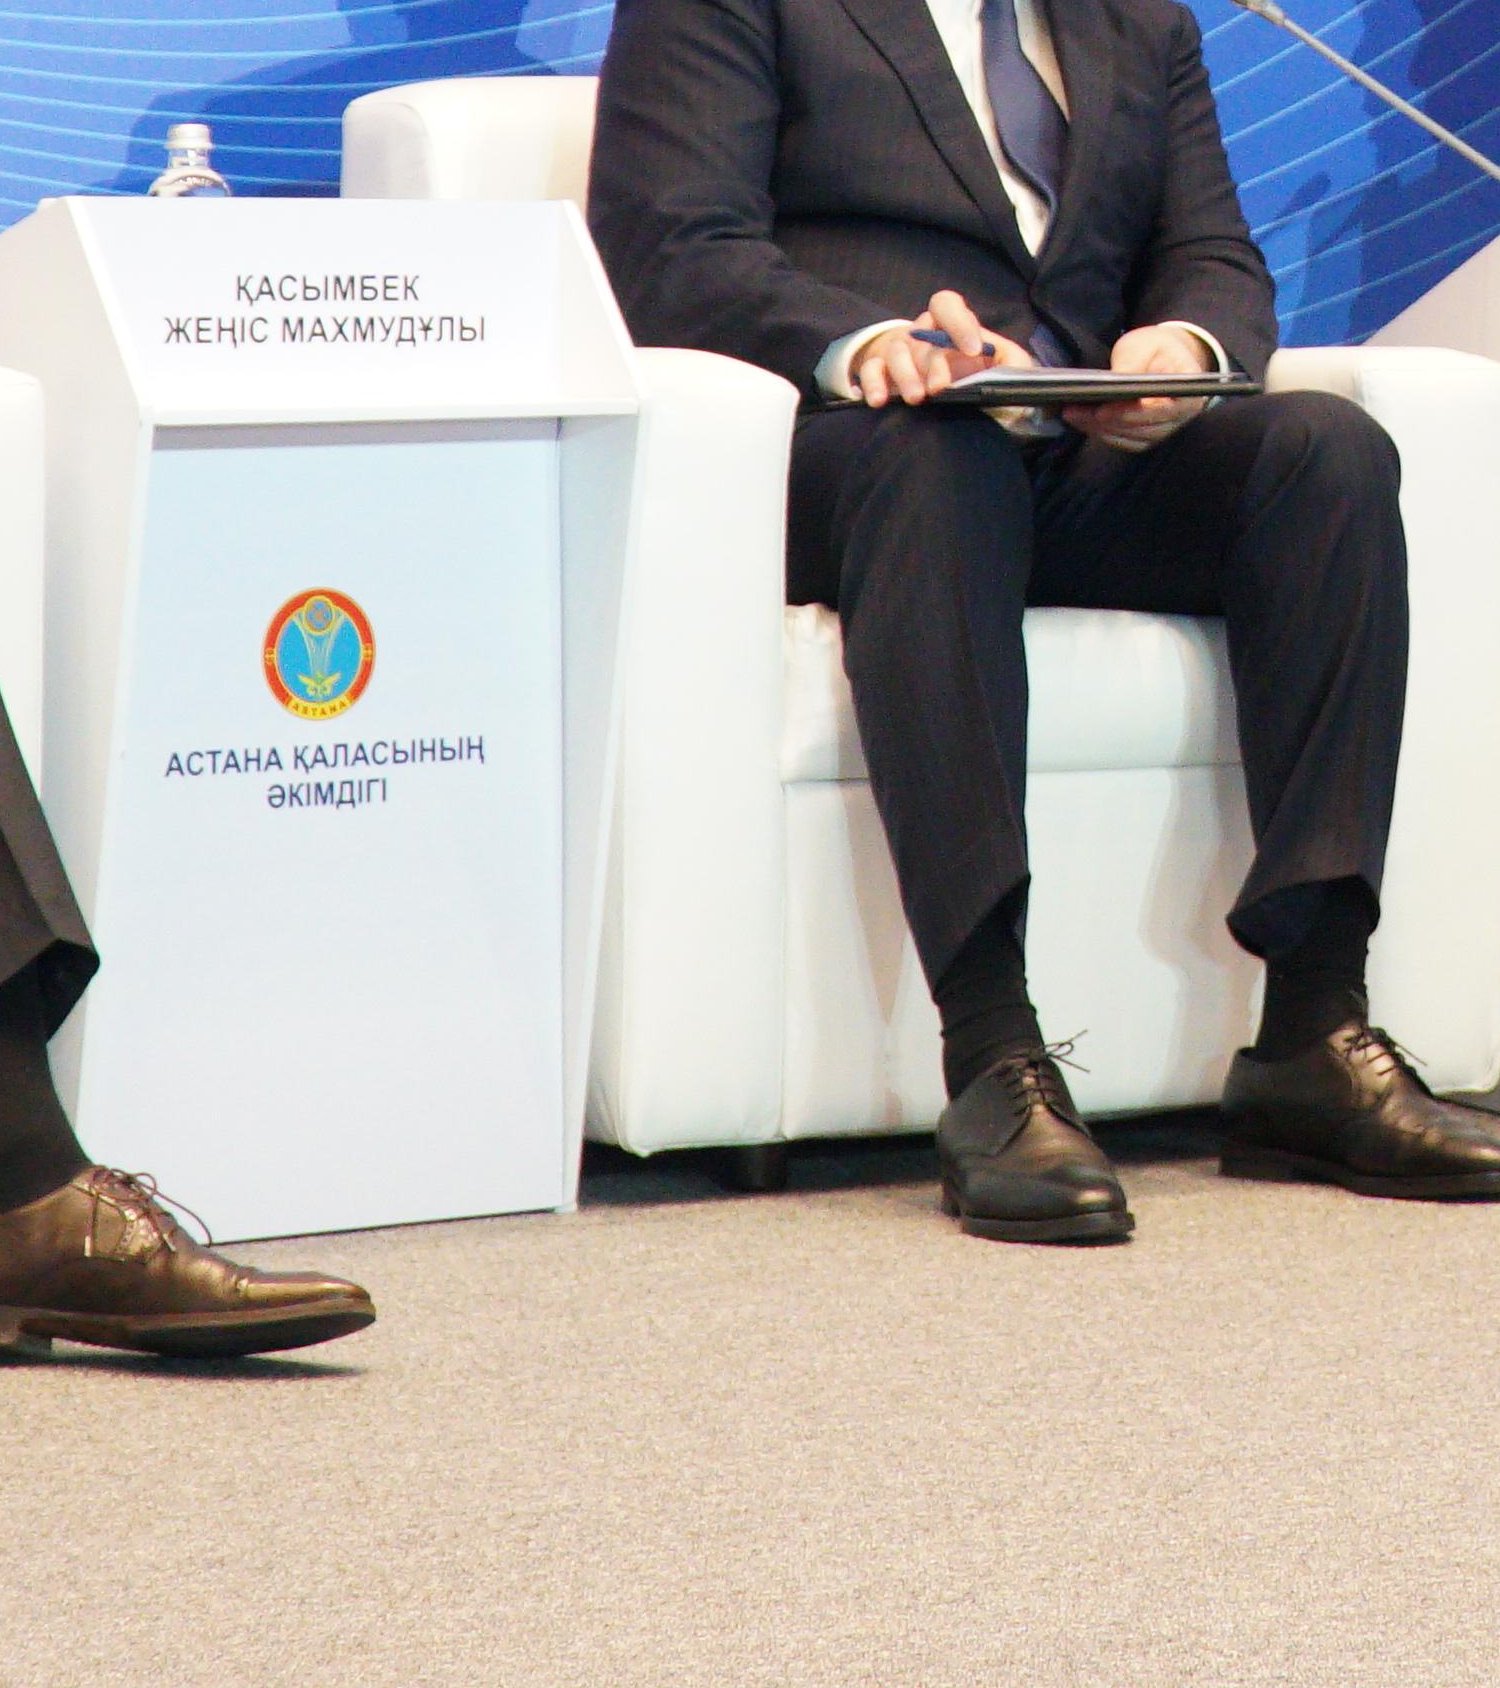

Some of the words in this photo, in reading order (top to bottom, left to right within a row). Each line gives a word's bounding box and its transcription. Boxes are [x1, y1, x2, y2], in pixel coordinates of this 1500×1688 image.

[235, 274, 420, 307] ҚАСЫМБЕК
[164, 316, 269, 349] ЖЕҢІС
[281, 316, 486, 348] МАХМУДҰЛЫ
[164, 747, 285, 778] АСТАНА
[292, 735, 486, 775] ҚАЛАСЫНЫҢ
[266, 778, 388, 809] ӘКІМДІГІ
